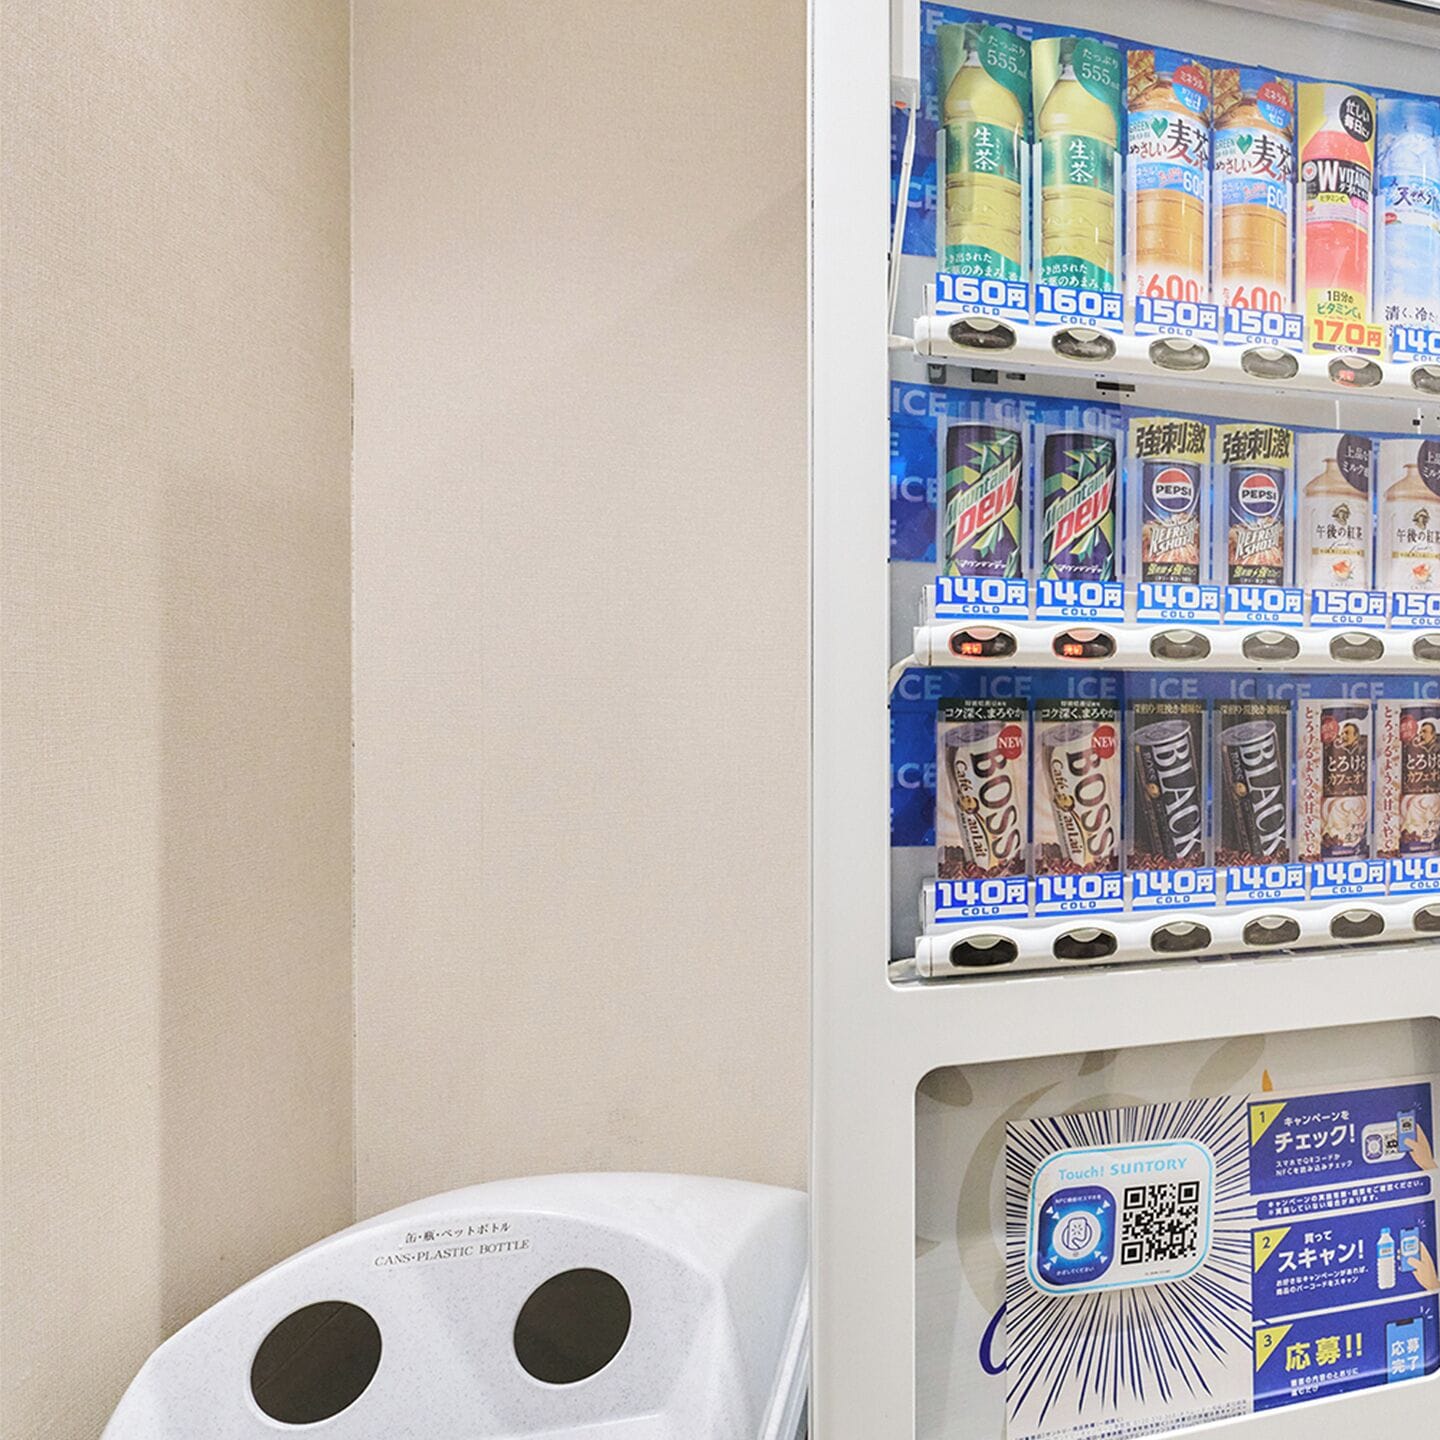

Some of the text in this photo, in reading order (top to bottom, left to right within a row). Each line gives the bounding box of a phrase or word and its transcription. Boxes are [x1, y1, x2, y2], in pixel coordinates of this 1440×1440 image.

[988, 36, 1025, 57] たっぷり
[1083, 49, 1119, 69] たっぷり
[1263, 87, 1288, 107] ミネラル
[1268, 113, 1283, 127] ゼロ
[974, 127, 998, 171] 生茶
[1167, 119, 1209, 171] 麦茶
[1069, 139, 1095, 183] 生茶
[1252, 134, 1292, 182] 麦茶
[1317, 160, 1339, 191] W
[939, 274, 1026, 309] 160円
[1327, 290, 1354, 304] 1日分の
[962, 305, 1000, 316] COLD
[1038, 285, 1121, 319] 160円
[1060, 315, 1096, 326] COLD
[1139, 298, 1216, 330] 150円
[1227, 307, 1301, 338] 150円
[1158, 325, 1193, 336] COLD
[1246, 334, 1279, 345] COLD
[1314, 319, 1382, 348] 170円
[894, 388, 948, 416] ICE
[1136, 422, 1206, 459] 強刺激
[1223, 427, 1290, 464] 強刺激
[1155, 485, 1191, 497] PEPSI
[1241, 490, 1277, 502] PEPSI
[1316, 524, 1363, 542] 午後の紅茶
[1397, 528, 1440, 545] 午後の紅茶
[938, 577, 1026, 604] 140円
[1039, 581, 1121, 607] 140円
[1140, 585, 1218, 609] 140円
[1228, 588, 1301, 612] 140円
[962, 605, 1000, 614] COLD
[1061, 608, 1098, 617] COLD
[1314, 591, 1384, 615] 150円
[1161, 610, 1194, 619] COLD
[1247, 613, 1279, 621] COLD
[1332, 615, 1363, 623] COLD
[1411, 617, 1440, 625] COLD
[980, 676, 1032, 699] ICE
[1068, 677, 1117, 699] ICE
[1150, 678, 1199, 699] ICE
[1342, 681, 1384, 699] ICE
[945, 707, 1021, 720] コク深く、まろやか
[1042, 707, 1115, 720] コク深く、まろやか
[1000, 736, 1022, 749] NEW
[1092, 736, 1116, 749] NEW
[969, 748, 1020, 859] BOSS
[1066, 749, 1115, 858] BOSS
[1152, 735, 1201, 859] BLACK
[1239, 736, 1286, 857] BLACK
[1136, 869, 1214, 894] 140円
[1229, 866, 1303, 890] 140円
[1315, 862, 1384, 885] 140円
[938, 880, 1025, 906] 140円
[1039, 875, 1121, 902] 140円
[1249, 890, 1281, 898] COLD
[1332, 885, 1363, 894] COLD
[1410, 880, 1440, 889] COLD
[1060, 900, 1096, 910] COLD
[1156, 895, 1190, 904] COLD
[962, 906, 1000, 916] COLD
[1260, 1111, 1266, 1123] 1
[1284, 1110, 1350, 1127] キャンペーンを
[1275, 1124, 1356, 1153] チェック!
[1059, 1166, 1105, 1182] Touch!
[1275, 1160, 1353, 1177] NFCを読み込みチェック
[405, 1222, 511, 1244] 缶・瓶・ペットボトル
[1262, 1236, 1271, 1249] 2
[1304, 1230, 1333, 1244] 買って
[479, 1239, 530, 1254] BOTTLE
[1278, 1240, 1364, 1273] スキャン!
[1275, 1276, 1359, 1296] 商品のバーコードをスキャン
[1264, 1334, 1273, 1347] 3
[1391, 1337, 1420, 1357] 応募
[1285, 1333, 1363, 1372] 応募!!
[1391, 1356, 1420, 1375] 完了
